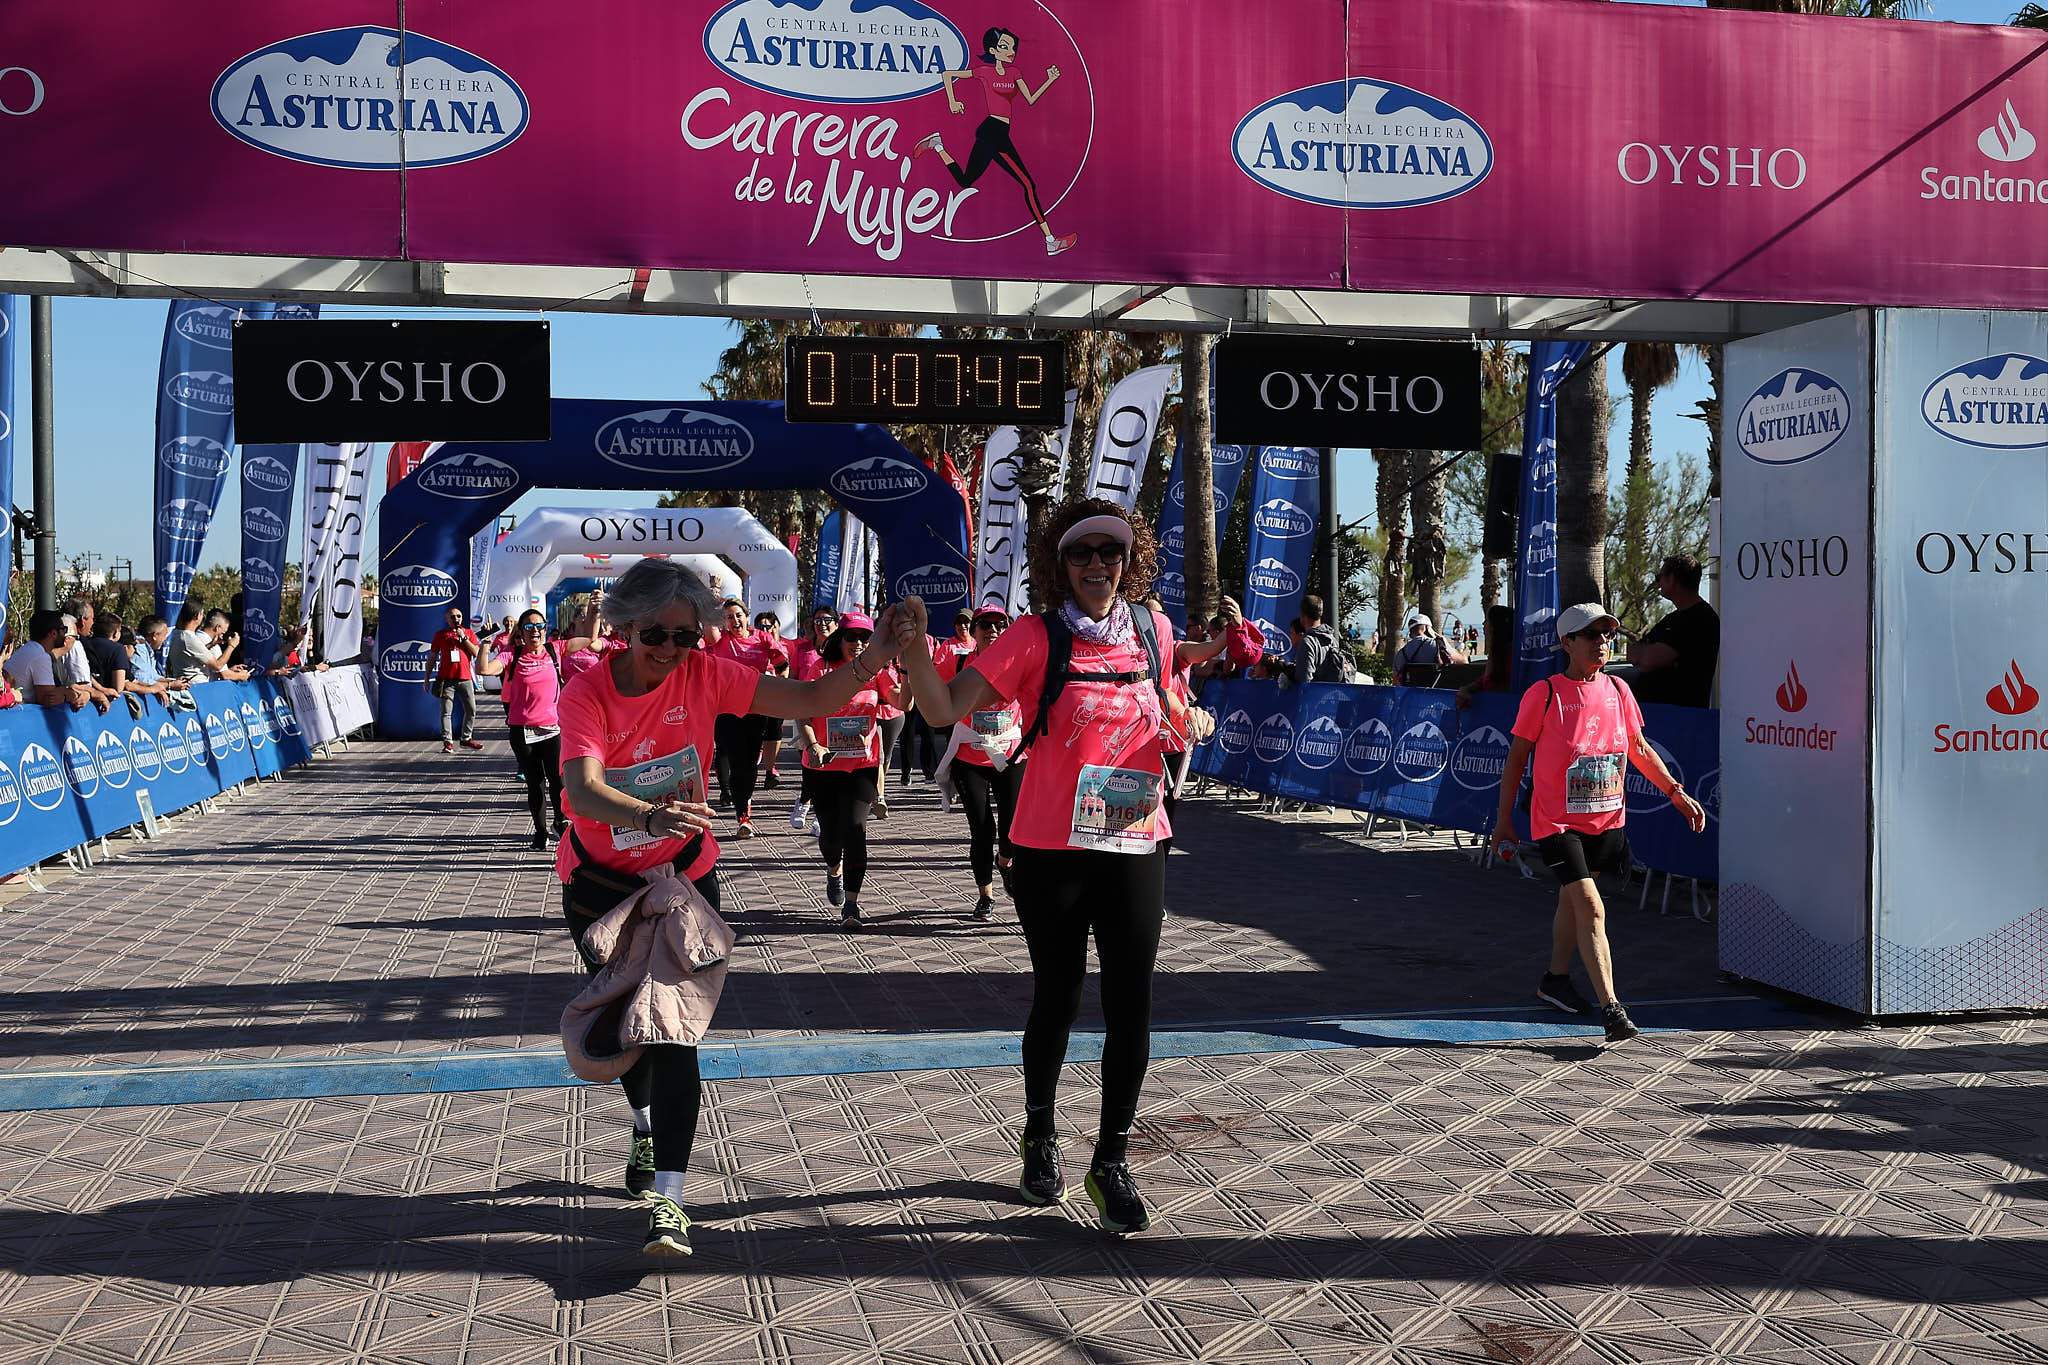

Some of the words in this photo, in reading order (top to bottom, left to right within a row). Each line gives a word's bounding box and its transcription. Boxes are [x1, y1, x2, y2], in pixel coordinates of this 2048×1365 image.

[766, 17, 850, 33] CENTRAL
[857, 23, 941, 38] LECHERA
[725, 18, 948, 74] ASTURIANA
[286, 73, 384, 89] CENTRAL
[236, 74, 505, 135] ASTURIANA
[681, 87, 900, 160] Carrera
[1294, 121, 1374, 135] CENTRAL
[1383, 125, 1465, 139] LECHERA
[1253, 122, 1474, 176] ASTURIANA
[1617, 142, 1807, 190] OYSHO
[735, 158, 775, 202] de
[784, 158, 814, 205] la
[807, 156, 979, 261] Mujer
[287, 359, 506, 403] OYSHO
[808, 351, 1043, 408] 01:07:42
[1962, 386, 2018, 396] CENTRAL
[1260, 371, 1444, 414] OYSHO
[1760, 401, 1796, 416] CENTRAL
[1798, 393, 1838, 409] LECHERA
[1743, 406, 1841, 446] ASTURIANA
[607, 428, 743, 457] ASTURIANA
[1263, 452, 1320, 475] ASTURIANA
[423, 471, 511, 488] ASTURIANA
[839, 475, 921, 491] ASTURIANA
[580, 516, 704, 541] OYSHO
[505, 545, 543, 554] OYSHO
[739, 543, 775, 552] OYSHO
[1737, 536, 1848, 580] OYSHO
[384, 581, 453, 597] ASTURIANA
[489, 594, 524, 603] OYSHO
[758, 593, 792, 602] OYSHO
[901, 580, 965, 595] ASTURIANA
[384, 656, 440, 672] ASTURI
[1298, 734, 1338, 757] ASTURIANA
[1745, 717, 1837, 751] Santander
[1347, 739, 1387, 762] ASTURIANA
[1397, 742, 1442, 768] ASTURIANA
[24, 771, 63, 797] ASTURIANA
